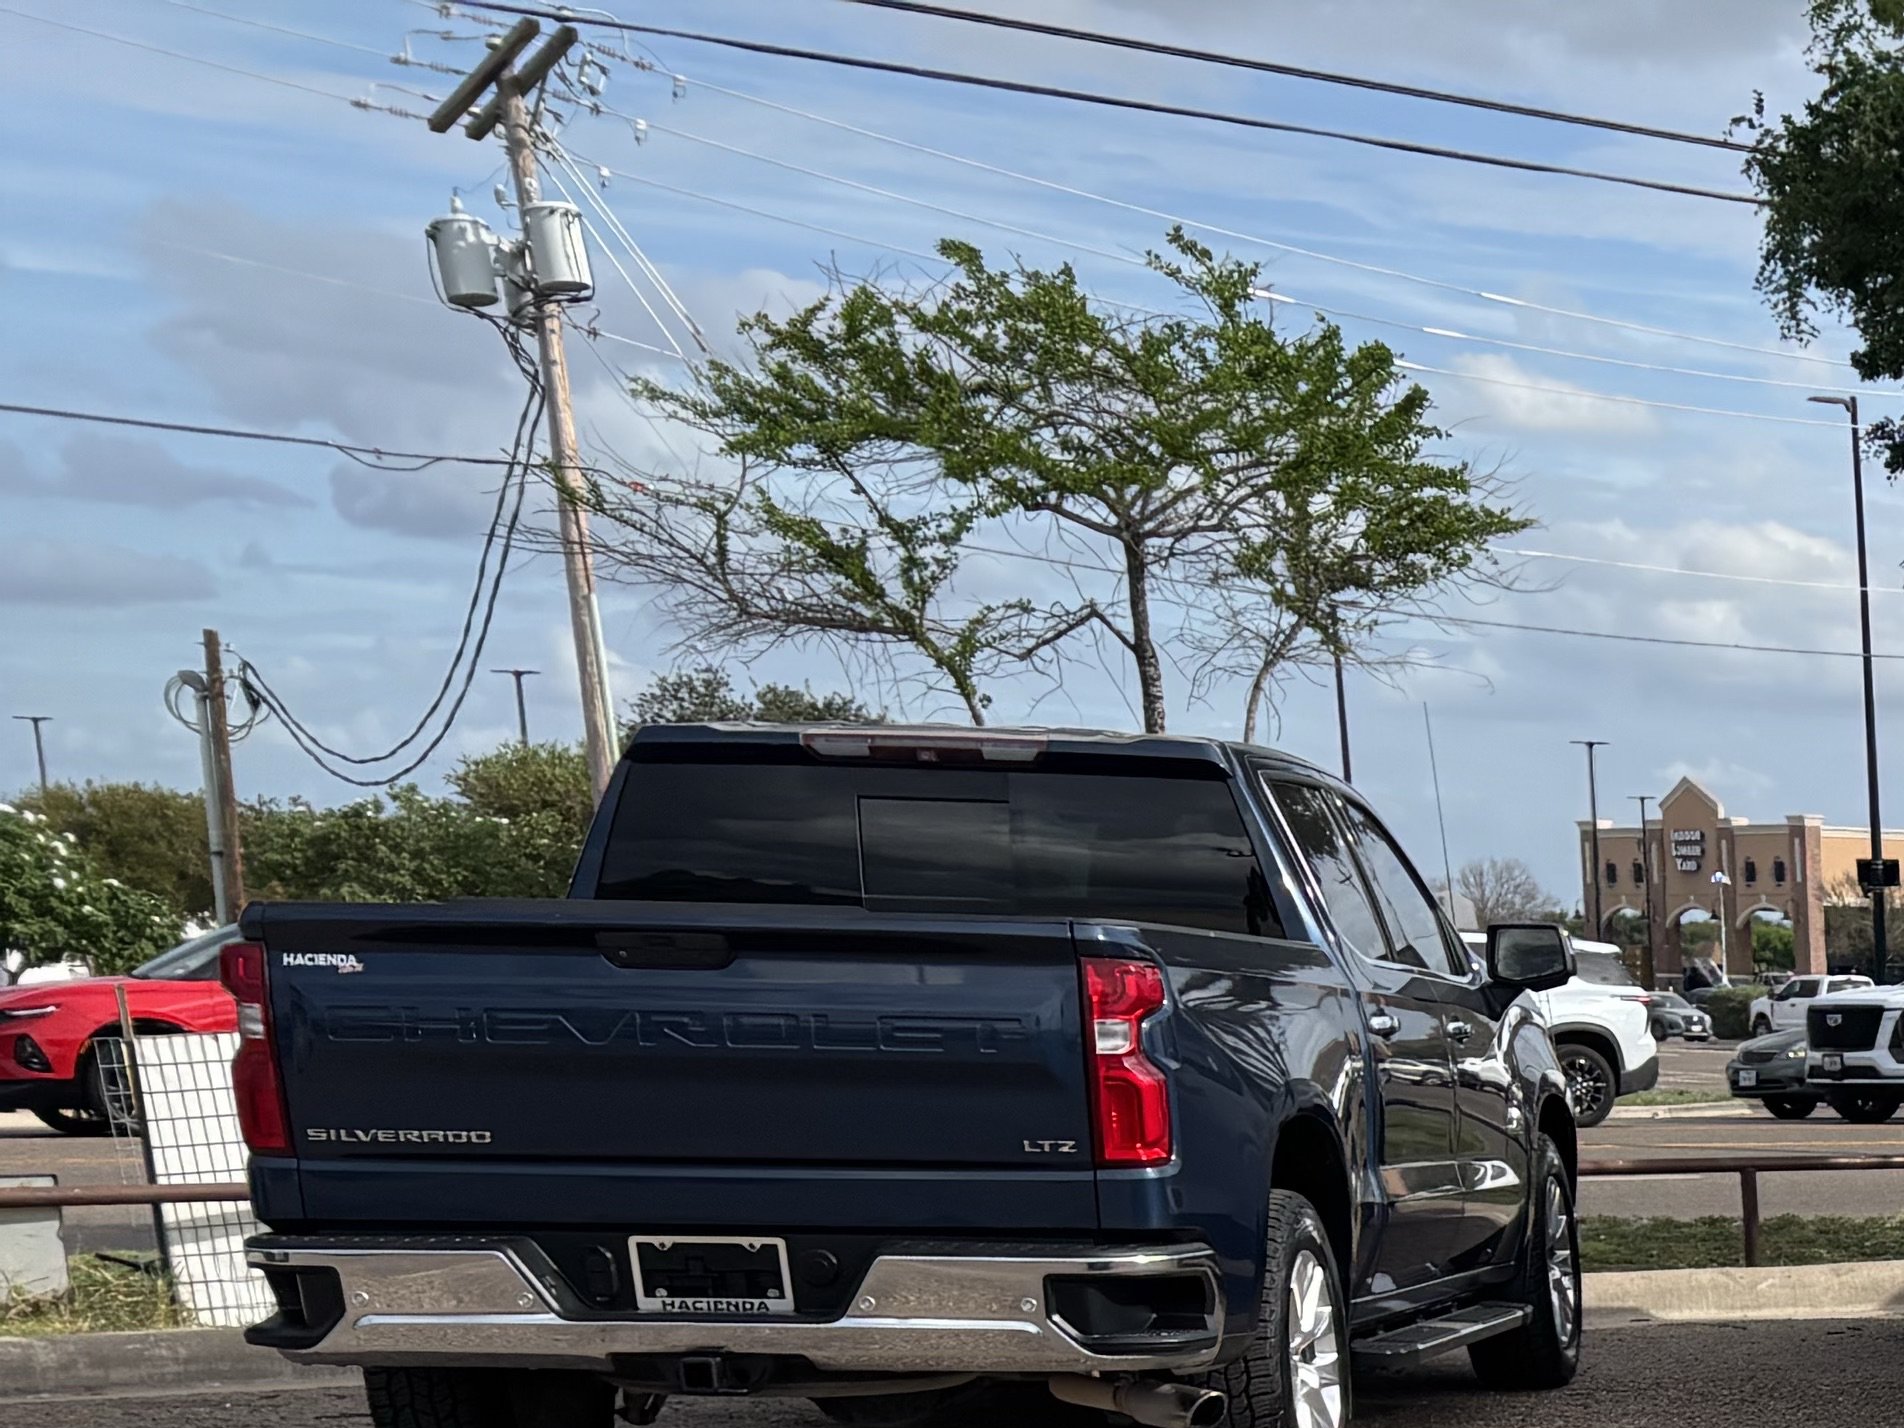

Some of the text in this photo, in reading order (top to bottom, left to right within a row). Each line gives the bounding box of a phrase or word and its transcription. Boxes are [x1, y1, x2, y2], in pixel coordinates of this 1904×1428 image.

[282, 952, 357, 967] HACIENDA
[325, 1005, 1027, 1053] CHEVROLET
[306, 1128, 492, 1144] SILVERADO
[1023, 1140, 1078, 1153] LTZ
[661, 1300, 770, 1313] HACIENDA
